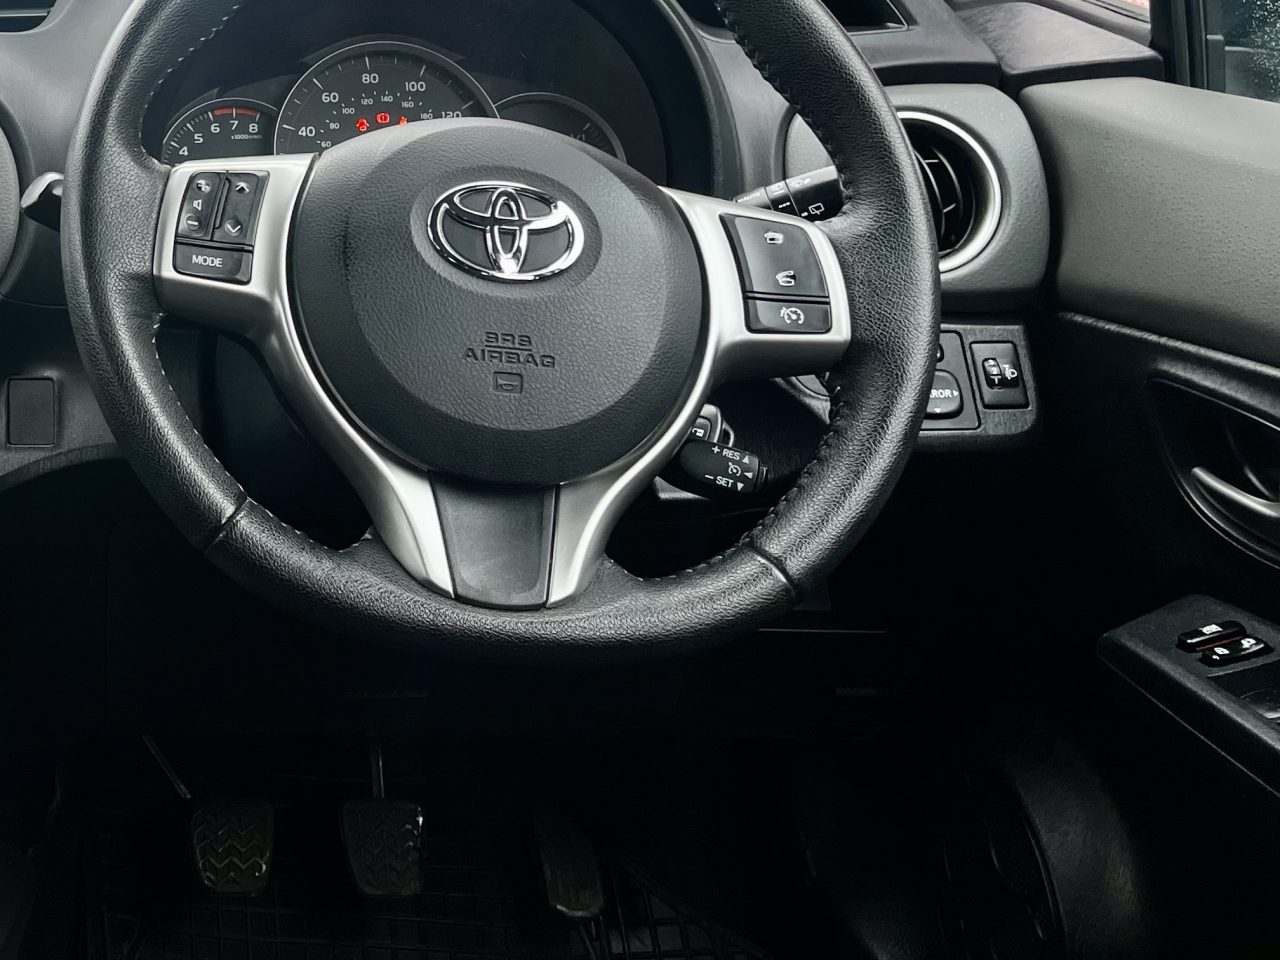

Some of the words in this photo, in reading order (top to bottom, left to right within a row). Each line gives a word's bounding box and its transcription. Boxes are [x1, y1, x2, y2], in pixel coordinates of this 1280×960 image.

[361, 73, 380, 85] 80
[405, 81, 427, 93] 100
[321, 92, 340, 104] 60
[360, 97, 374, 106] 120
[380, 95, 394, 103] 140
[401, 100, 415, 109] 160
[341, 107, 356, 116] 100
[210, 123, 221, 134] 6
[229, 120, 239, 131] 7
[248, 123, 259, 134] 8
[329, 122, 340, 130] 80
[297, 125, 316, 138] 40
[194, 133, 204, 144] 5
[320, 140, 332, 149] 60
[178, 146, 189, 157] 4
[191, 254, 223, 268] MODE
[484, 331, 532, 346] SRS
[464, 347, 556, 368] AIRBAG
[722, 448, 741, 461] RES
[715, 475, 734, 488] SET
